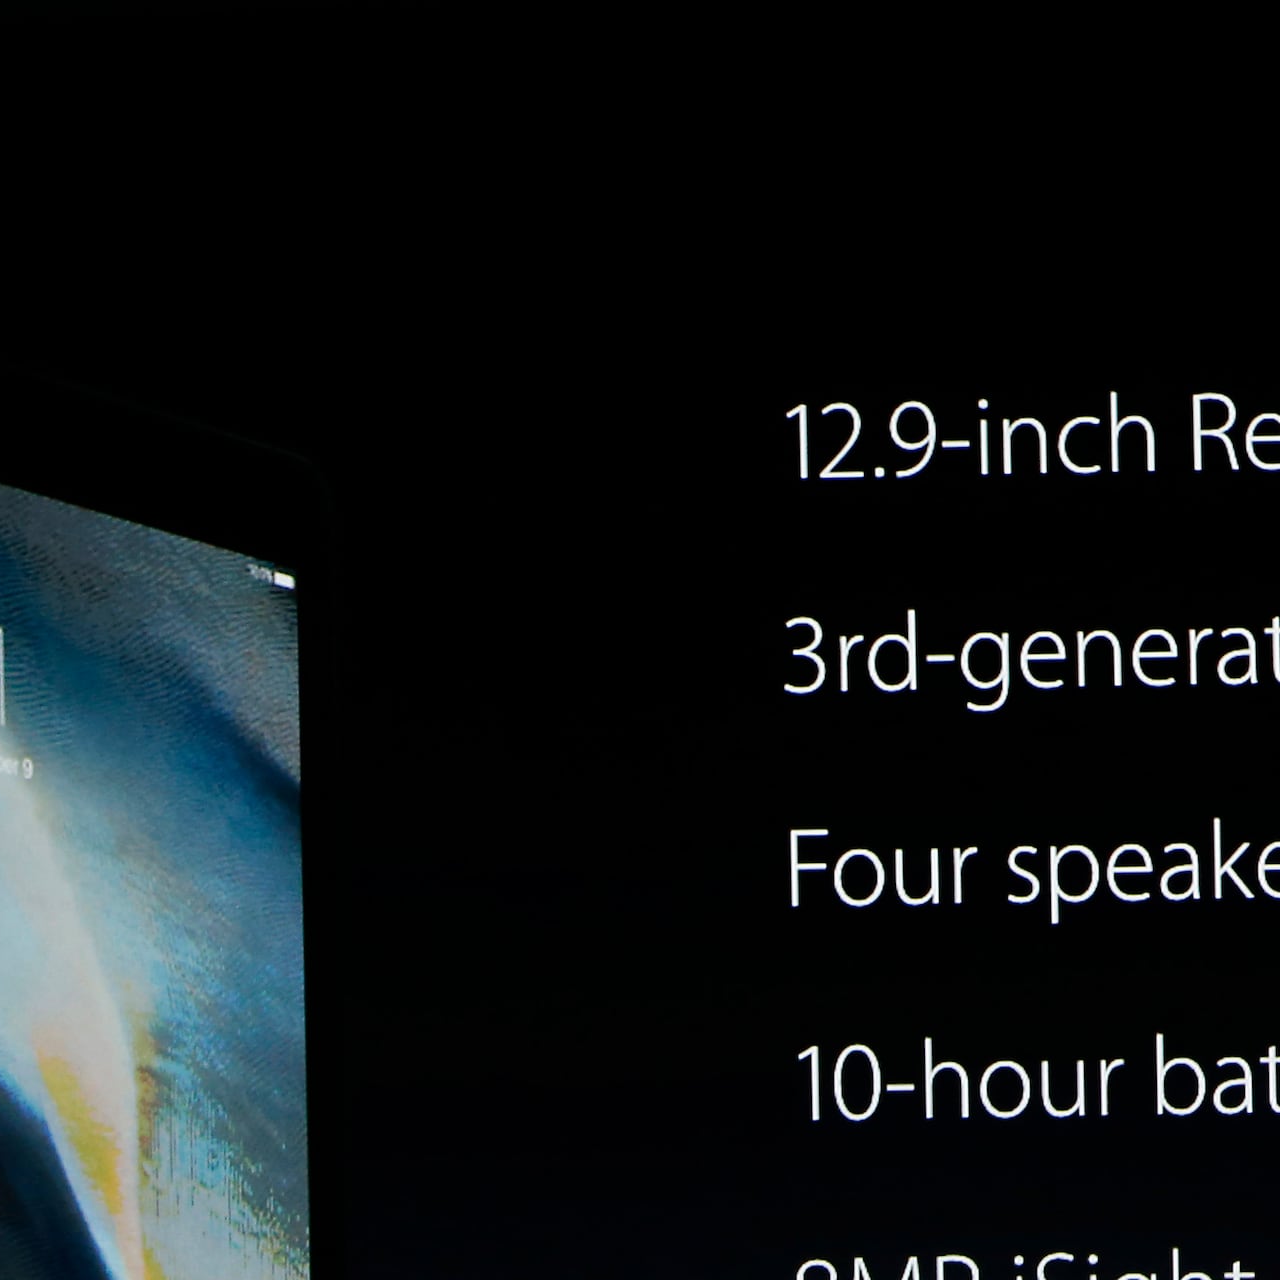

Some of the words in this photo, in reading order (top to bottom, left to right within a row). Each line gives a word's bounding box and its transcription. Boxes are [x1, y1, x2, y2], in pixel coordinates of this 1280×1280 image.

[785, 390, 1156, 480] 12.9-inch
[22, 757, 34, 780] 9
[789, 828, 979, 908] Four
[797, 1036, 1125, 1122] 10-hour
